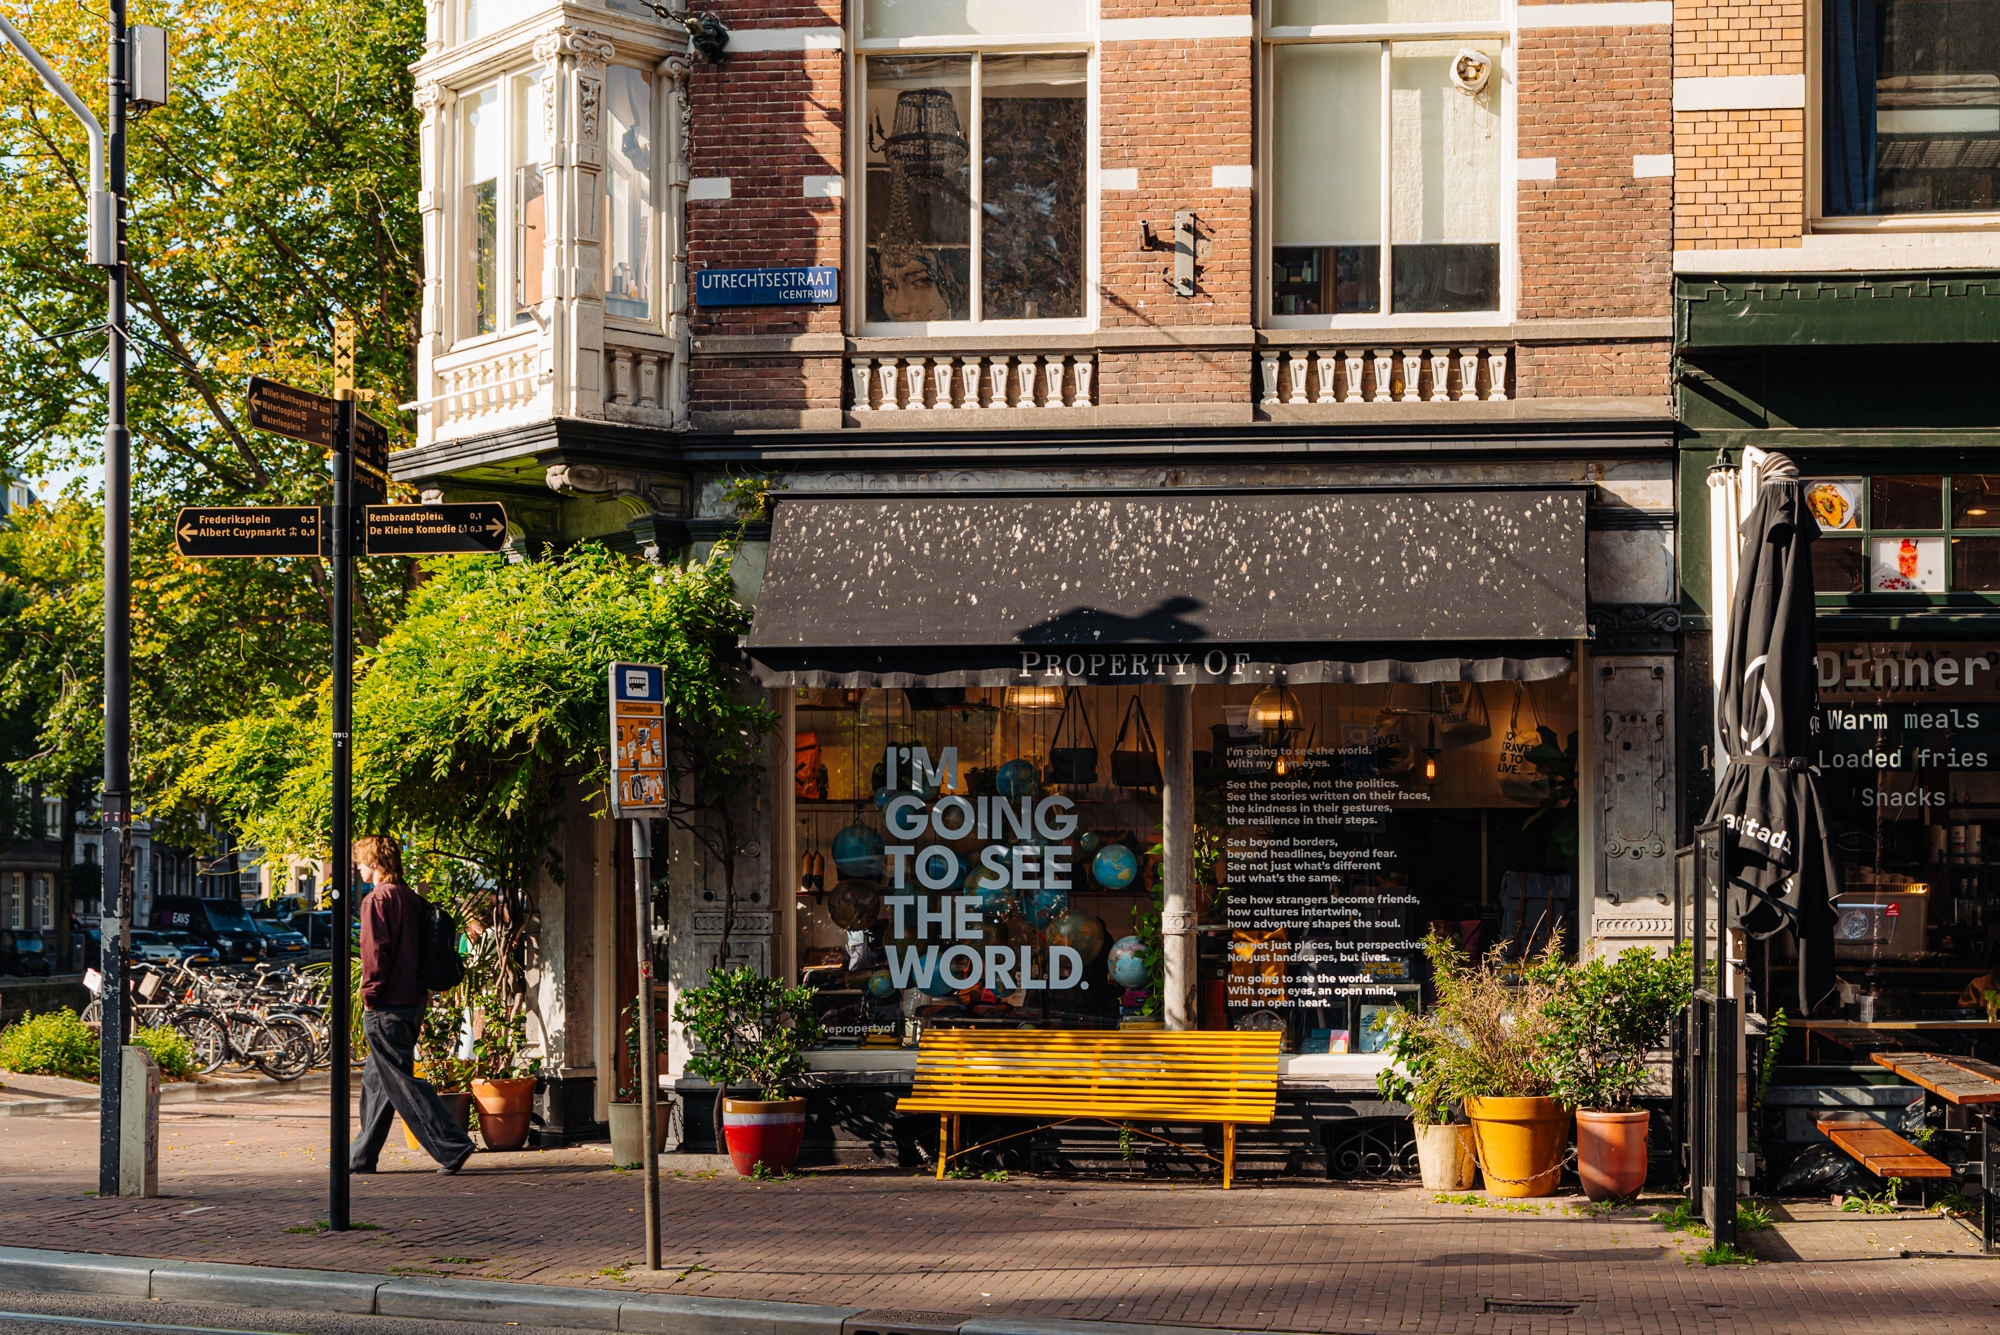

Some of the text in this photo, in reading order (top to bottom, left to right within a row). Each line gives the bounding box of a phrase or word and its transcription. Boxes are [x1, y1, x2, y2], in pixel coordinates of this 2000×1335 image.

[702, 272, 832, 289] UTRECHTSESTRAAT
[779, 289, 833, 299] (CENTRUM)
[262, 400, 301, 418] Waterlooplein
[262, 414, 301, 432] Waterlooplein
[199, 515, 315, 526] Frederiksplein 0,5
[370, 512, 482, 523] Rembrandtplein 0,1
[199, 527, 315, 539] Albert Cuypmarkt 0,9
[370, 524, 483, 535] De Kleine Komedie 0,3
[1018, 651, 1191, 678] PROPERTY
[1818, 647, 1990, 687] Dinner
[1827, 710, 1888, 730] Warm
[1904, 709, 1980, 729] meals
[337, 740, 343, 748] 2
[1227, 746, 1243, 756] I'm
[1246, 746, 1277, 758] going
[1281, 746, 1291, 756] to
[1317, 745, 1334, 755] the
[1338, 745, 1372, 755] world.
[1500, 752, 1524, 764] IS TO
[1699, 745, 1715, 771] 1
[1818, 747, 1989, 769] Loaded fries
[886, 746, 958, 791] I'M
[1227, 757, 1330, 770] With my own eyes.
[1497, 763, 1521, 775] LIVE.
[1227, 778, 1399, 791] See the people, not the politics.
[1227, 790, 1430, 801] See the stories written on their faces,
[1861, 788, 1946, 807] Snacks
[1227, 802, 1392, 814] the kindness in their gestures,
[885, 795, 1078, 840] GOING
[1227, 814, 1377, 827] the resilience in their steps.
[1227, 836, 1338, 849] See beyond borders,
[1227, 848, 1397, 861] beyond headlines, beyond fear.
[884, 845, 1072, 890] TO SEE
[1227, 860, 1381, 873] See not just what's different
[1227, 872, 1341, 882] but what's the same.
[1227, 893, 1420, 906] See how strangers become friends,
[884, 895, 984, 940] THE
[1228, 906, 1361, 917] how cultures intertwine,
[1228, 918, 1400, 930] how adventure shapes the soul.
[1228, 940, 1247, 950] See
[1250, 940, 1268, 950] not
[1271, 940, 1291, 952] just
[1295, 939, 1332, 952] places,
[1336, 939, 1354, 949] but
[1228, 952, 1389, 964] Not just landscapes, but lives.
[884, 944, 1090, 990] WORLD.
[1228, 973, 1373, 986] I'm going to see the world.
[1228, 985, 1397, 997] With open eyes, an open mind,
[1228, 997, 1330, 1010] and an open heart.
